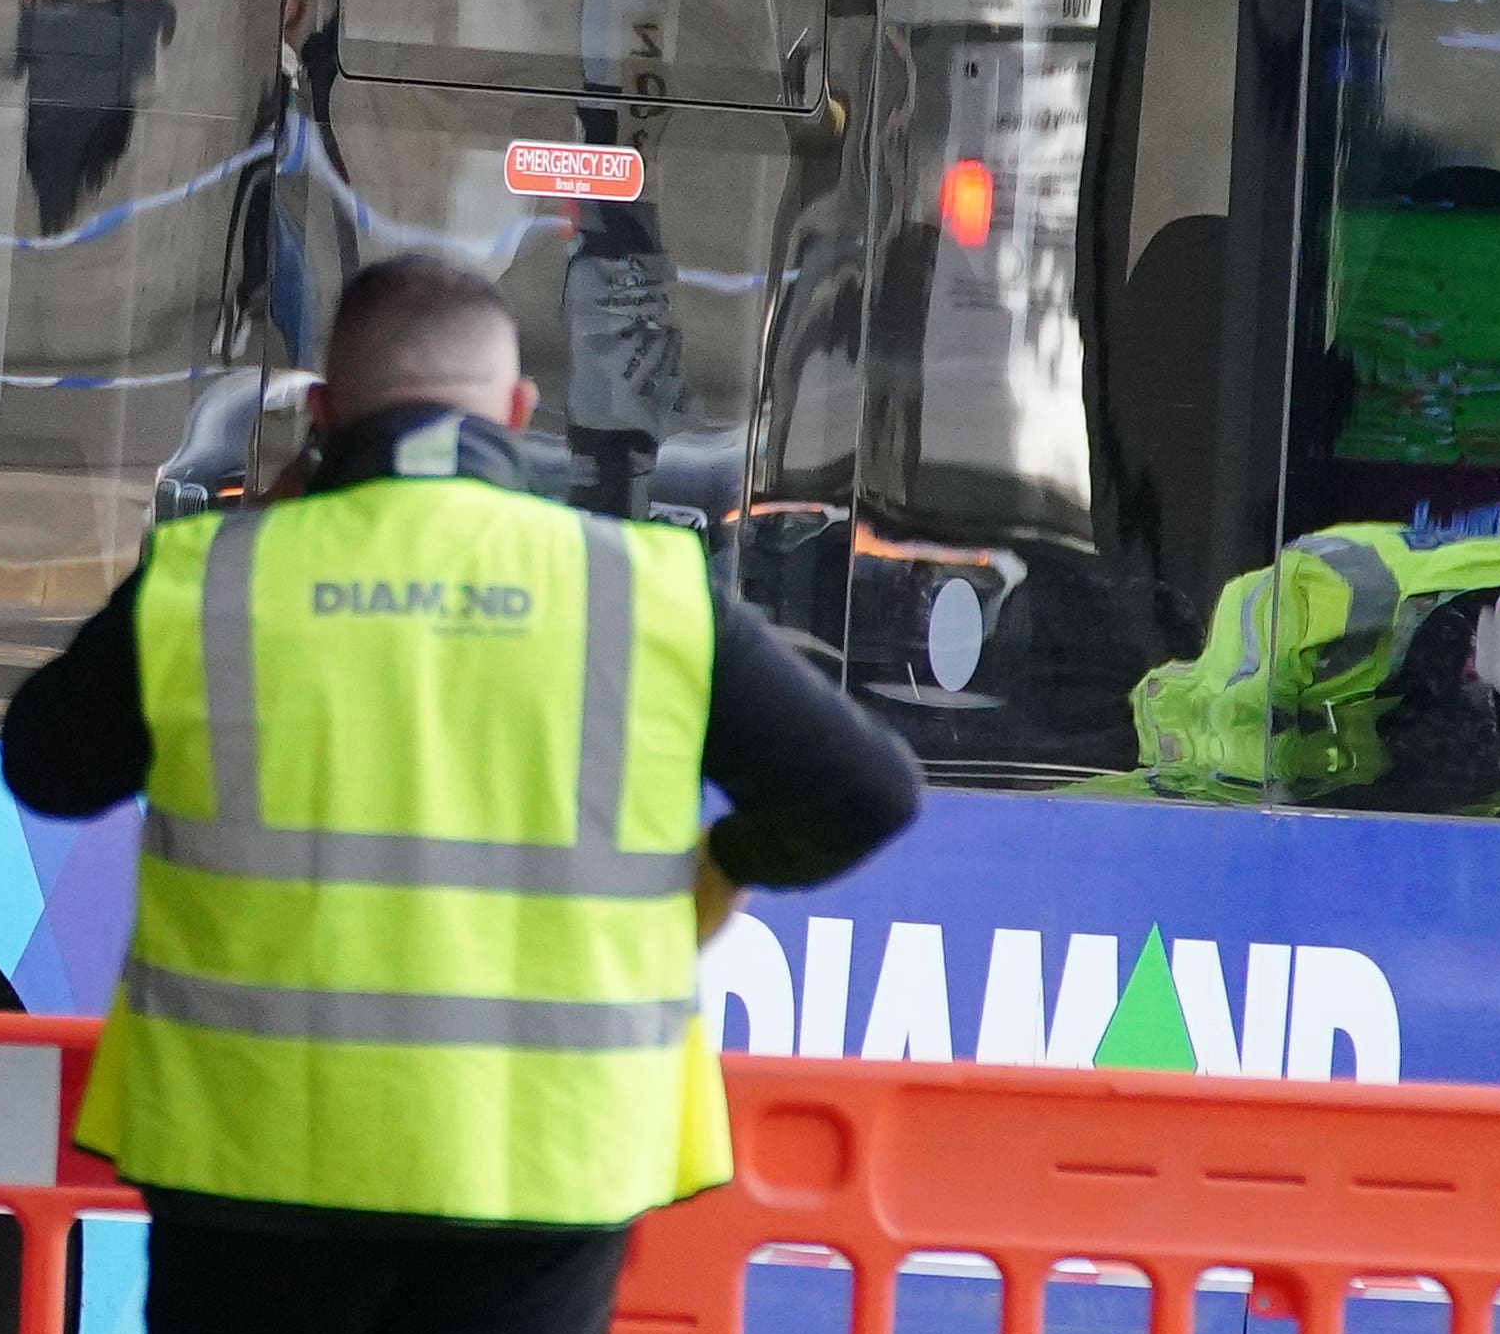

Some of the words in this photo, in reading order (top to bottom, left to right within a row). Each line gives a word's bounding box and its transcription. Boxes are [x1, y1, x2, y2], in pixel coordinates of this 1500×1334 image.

[515, 147, 600, 177] EMERGENCY
[602, 154, 635, 179] EXIT
[313, 581, 532, 617] DIAMND
